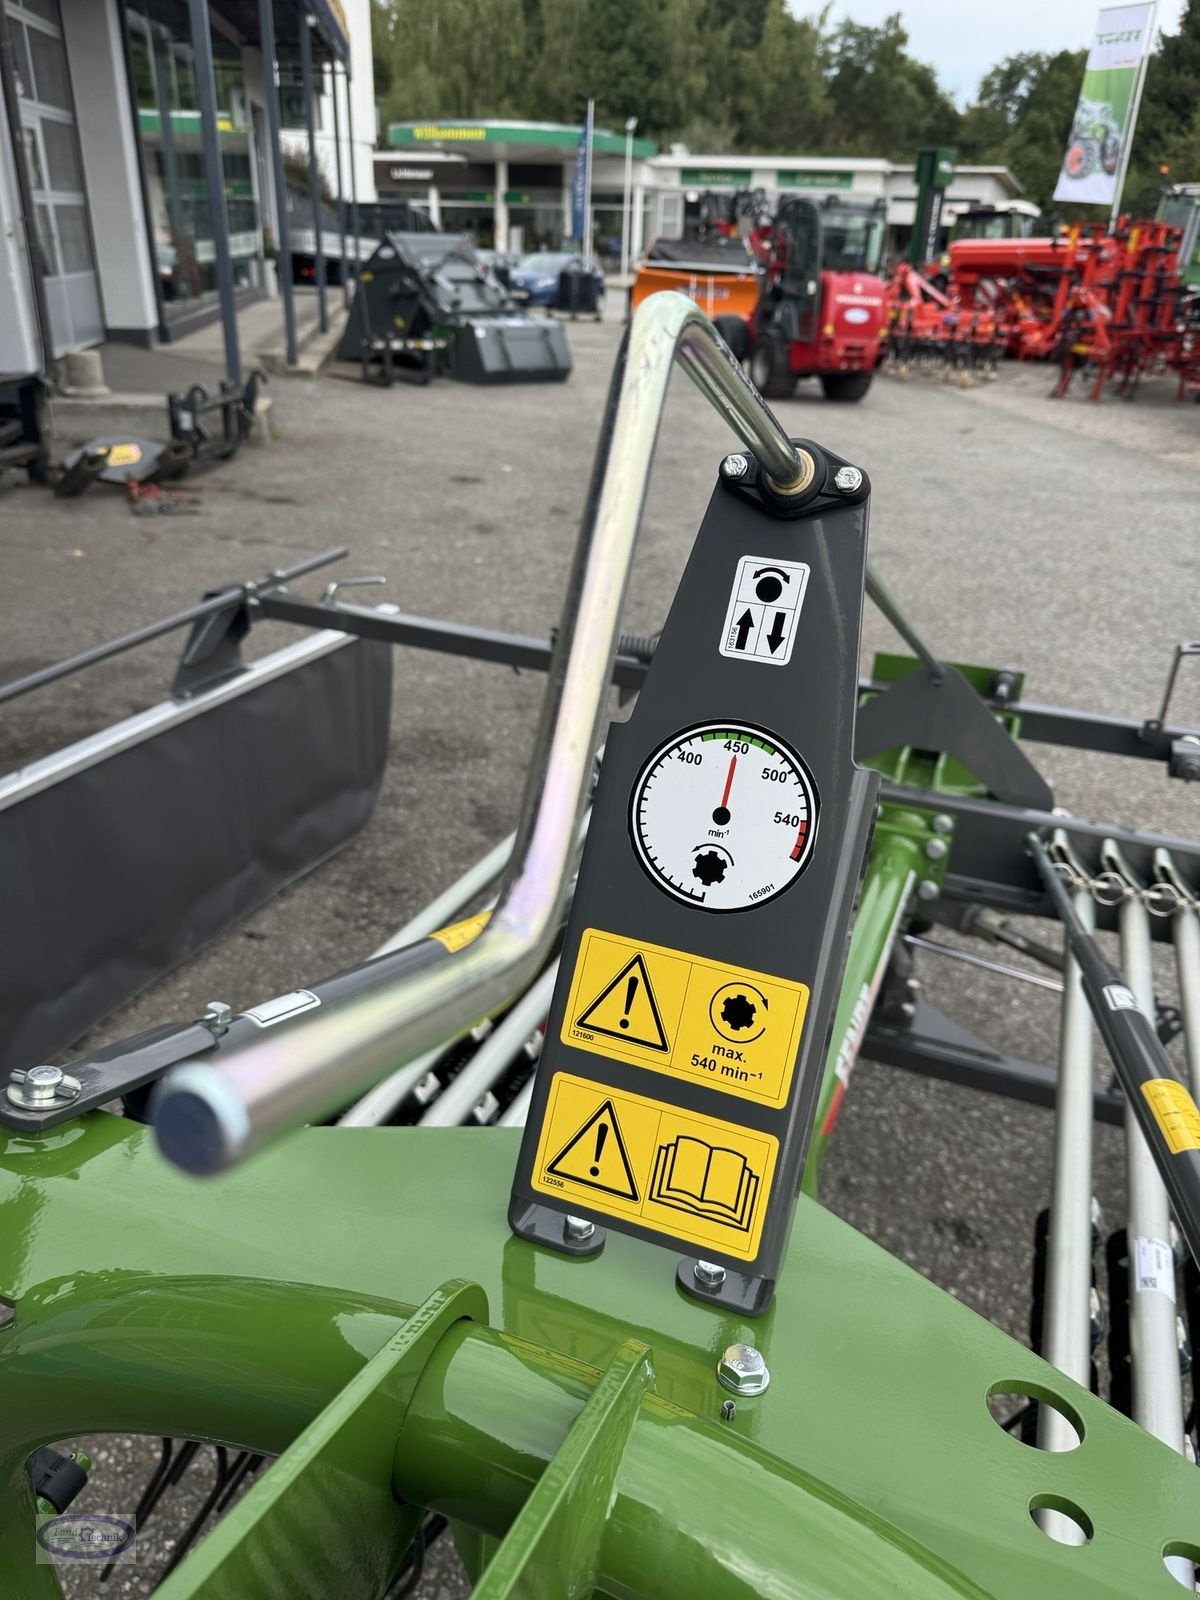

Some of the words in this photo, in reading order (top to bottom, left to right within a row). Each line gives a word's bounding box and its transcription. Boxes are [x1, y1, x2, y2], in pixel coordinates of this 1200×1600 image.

[413, 123, 486, 140] Willkommen
[728, 626, 738, 649] 163156
[723, 739, 749, 755] 450
[677, 750, 703, 766] 400
[761, 767, 788, 784] 500
[773, 811, 800, 828] 540
[748, 883, 776, 901] 165901
[572, 1029, 595, 1041] 121600
[712, 1044, 746, 1063] max.
[690, 1054, 717, 1072] 540
[543, 1176, 565, 1188] 122556
